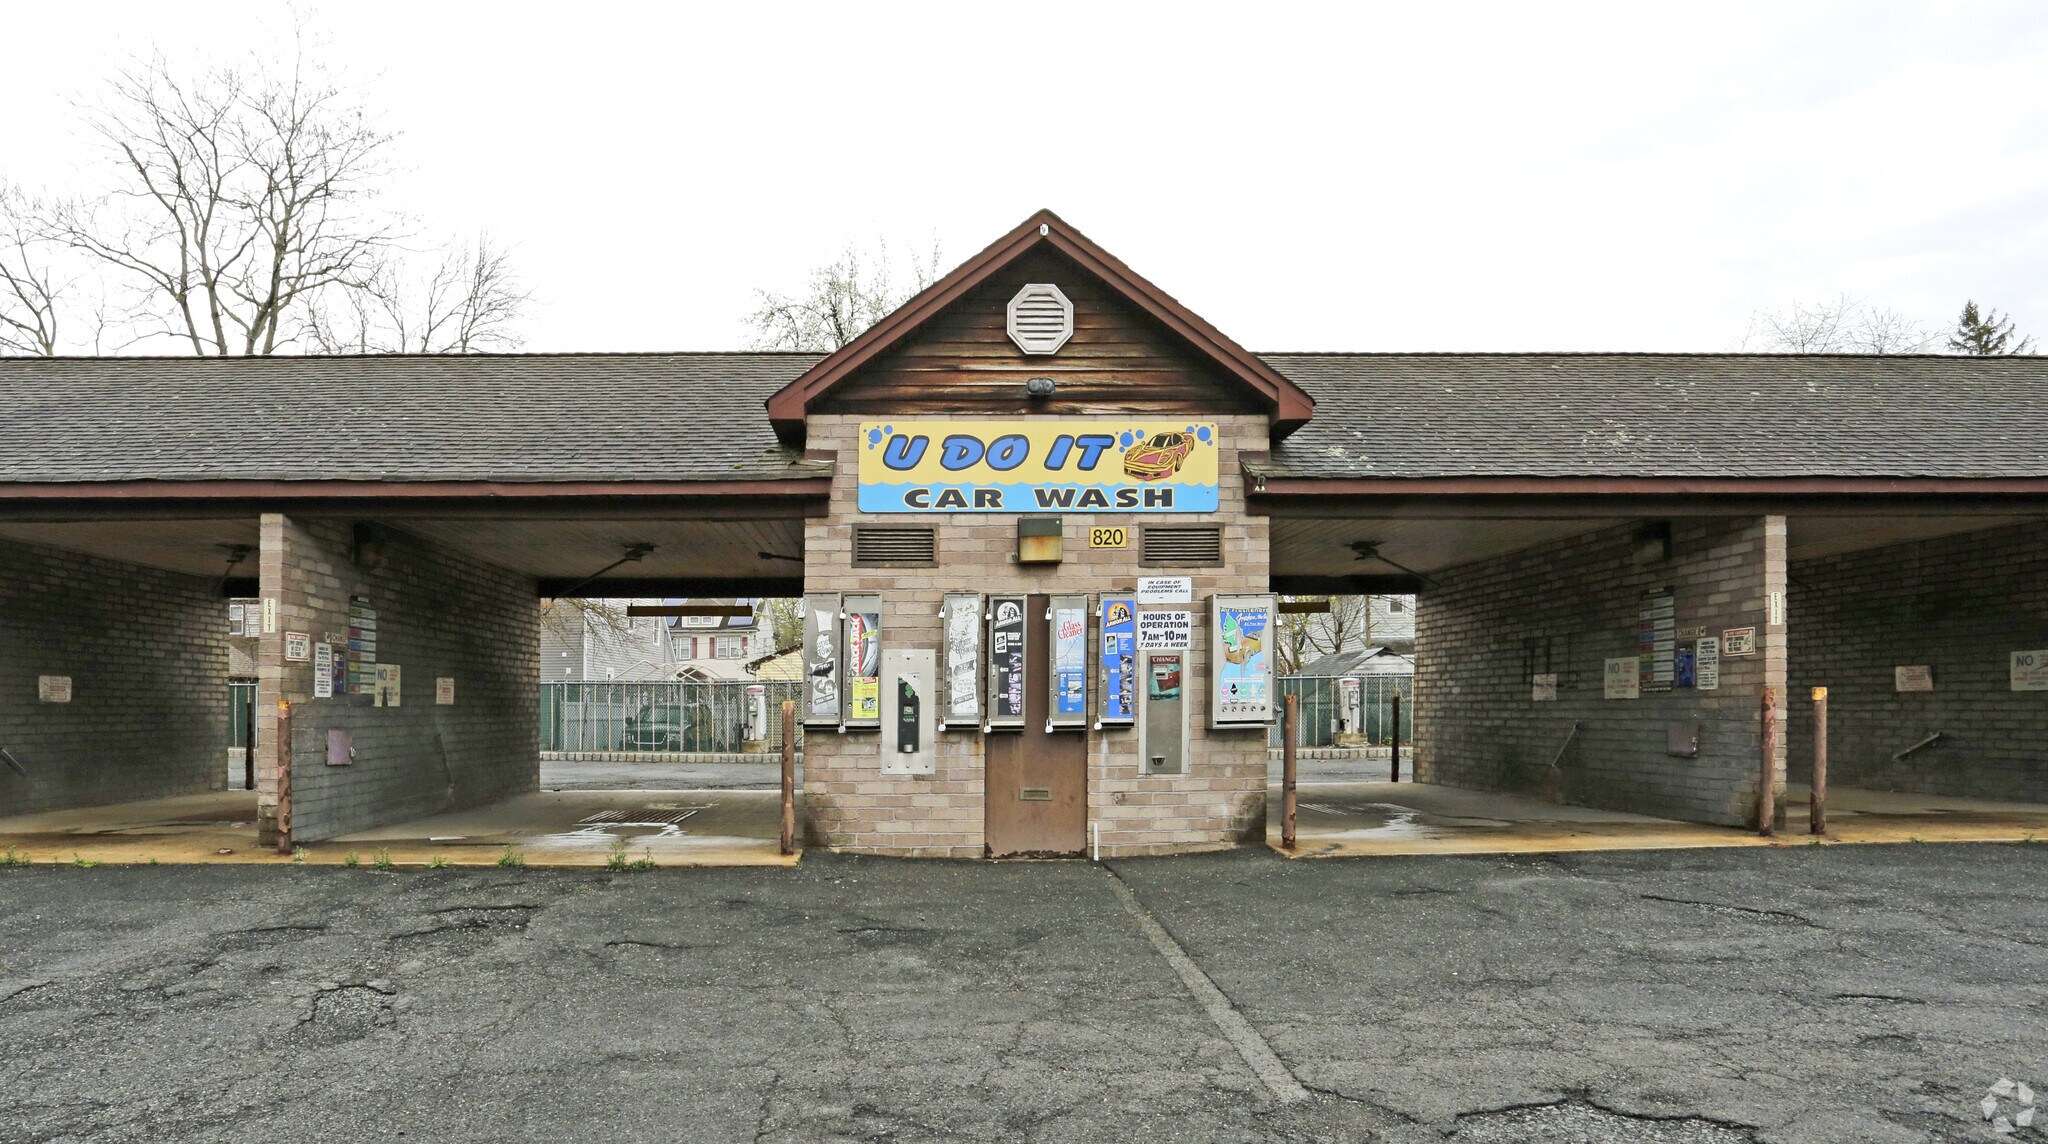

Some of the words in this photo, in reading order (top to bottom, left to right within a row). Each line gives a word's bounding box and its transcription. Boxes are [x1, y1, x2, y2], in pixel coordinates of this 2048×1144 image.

[883, 434, 930, 471] U
[939, 434, 1030, 471] DO
[1044, 434, 1115, 471] IT
[904, 488, 1004, 508] CAR
[1032, 488, 1175, 508] WASH
[1092, 529, 1123, 545] 820
[852, 617, 860, 642] JACK
[1063, 620, 1081, 632] Glass
[1058, 627, 1084, 640] Cleaner
[2016, 655, 2034, 666] NO
[378, 668, 387, 680] NO
[1608, 663, 1619, 673] NO
